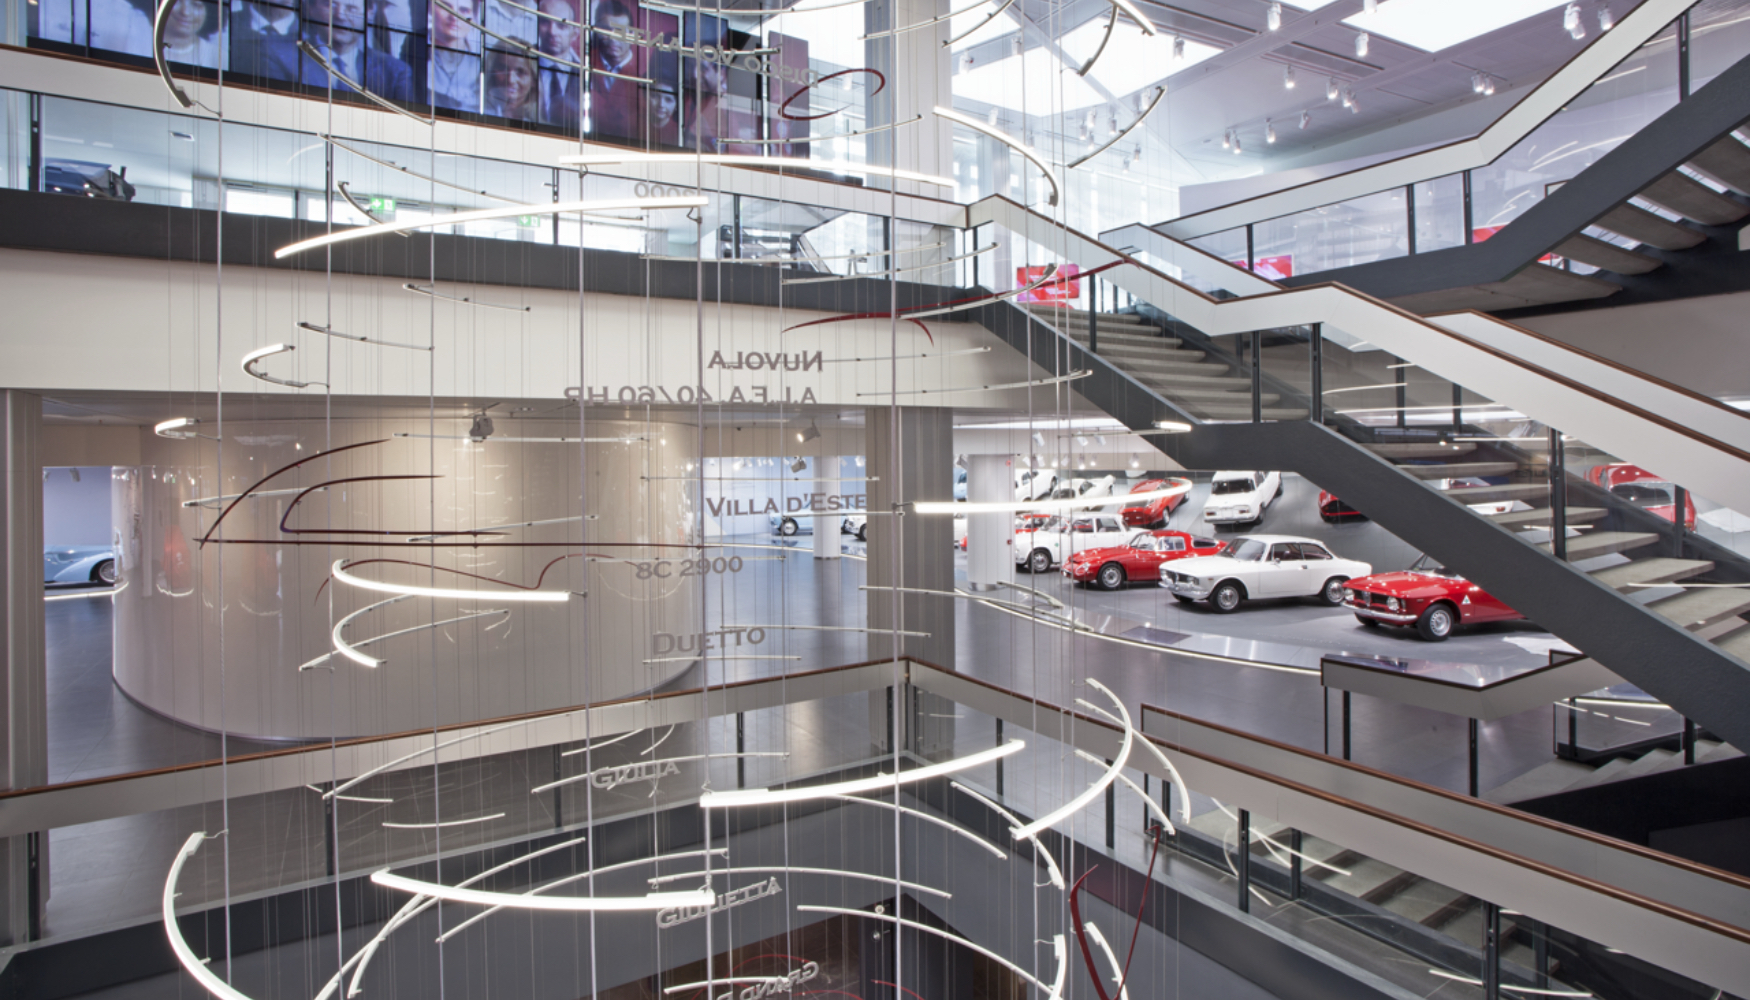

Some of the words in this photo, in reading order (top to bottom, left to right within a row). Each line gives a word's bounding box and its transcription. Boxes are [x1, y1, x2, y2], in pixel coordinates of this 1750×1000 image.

[705, 497, 779, 517] VILLA
[636, 561, 672, 580] 8C
[679, 555, 744, 577] 2900
[652, 627, 766, 656] DUETTO
[591, 760, 681, 789] GIULIA
